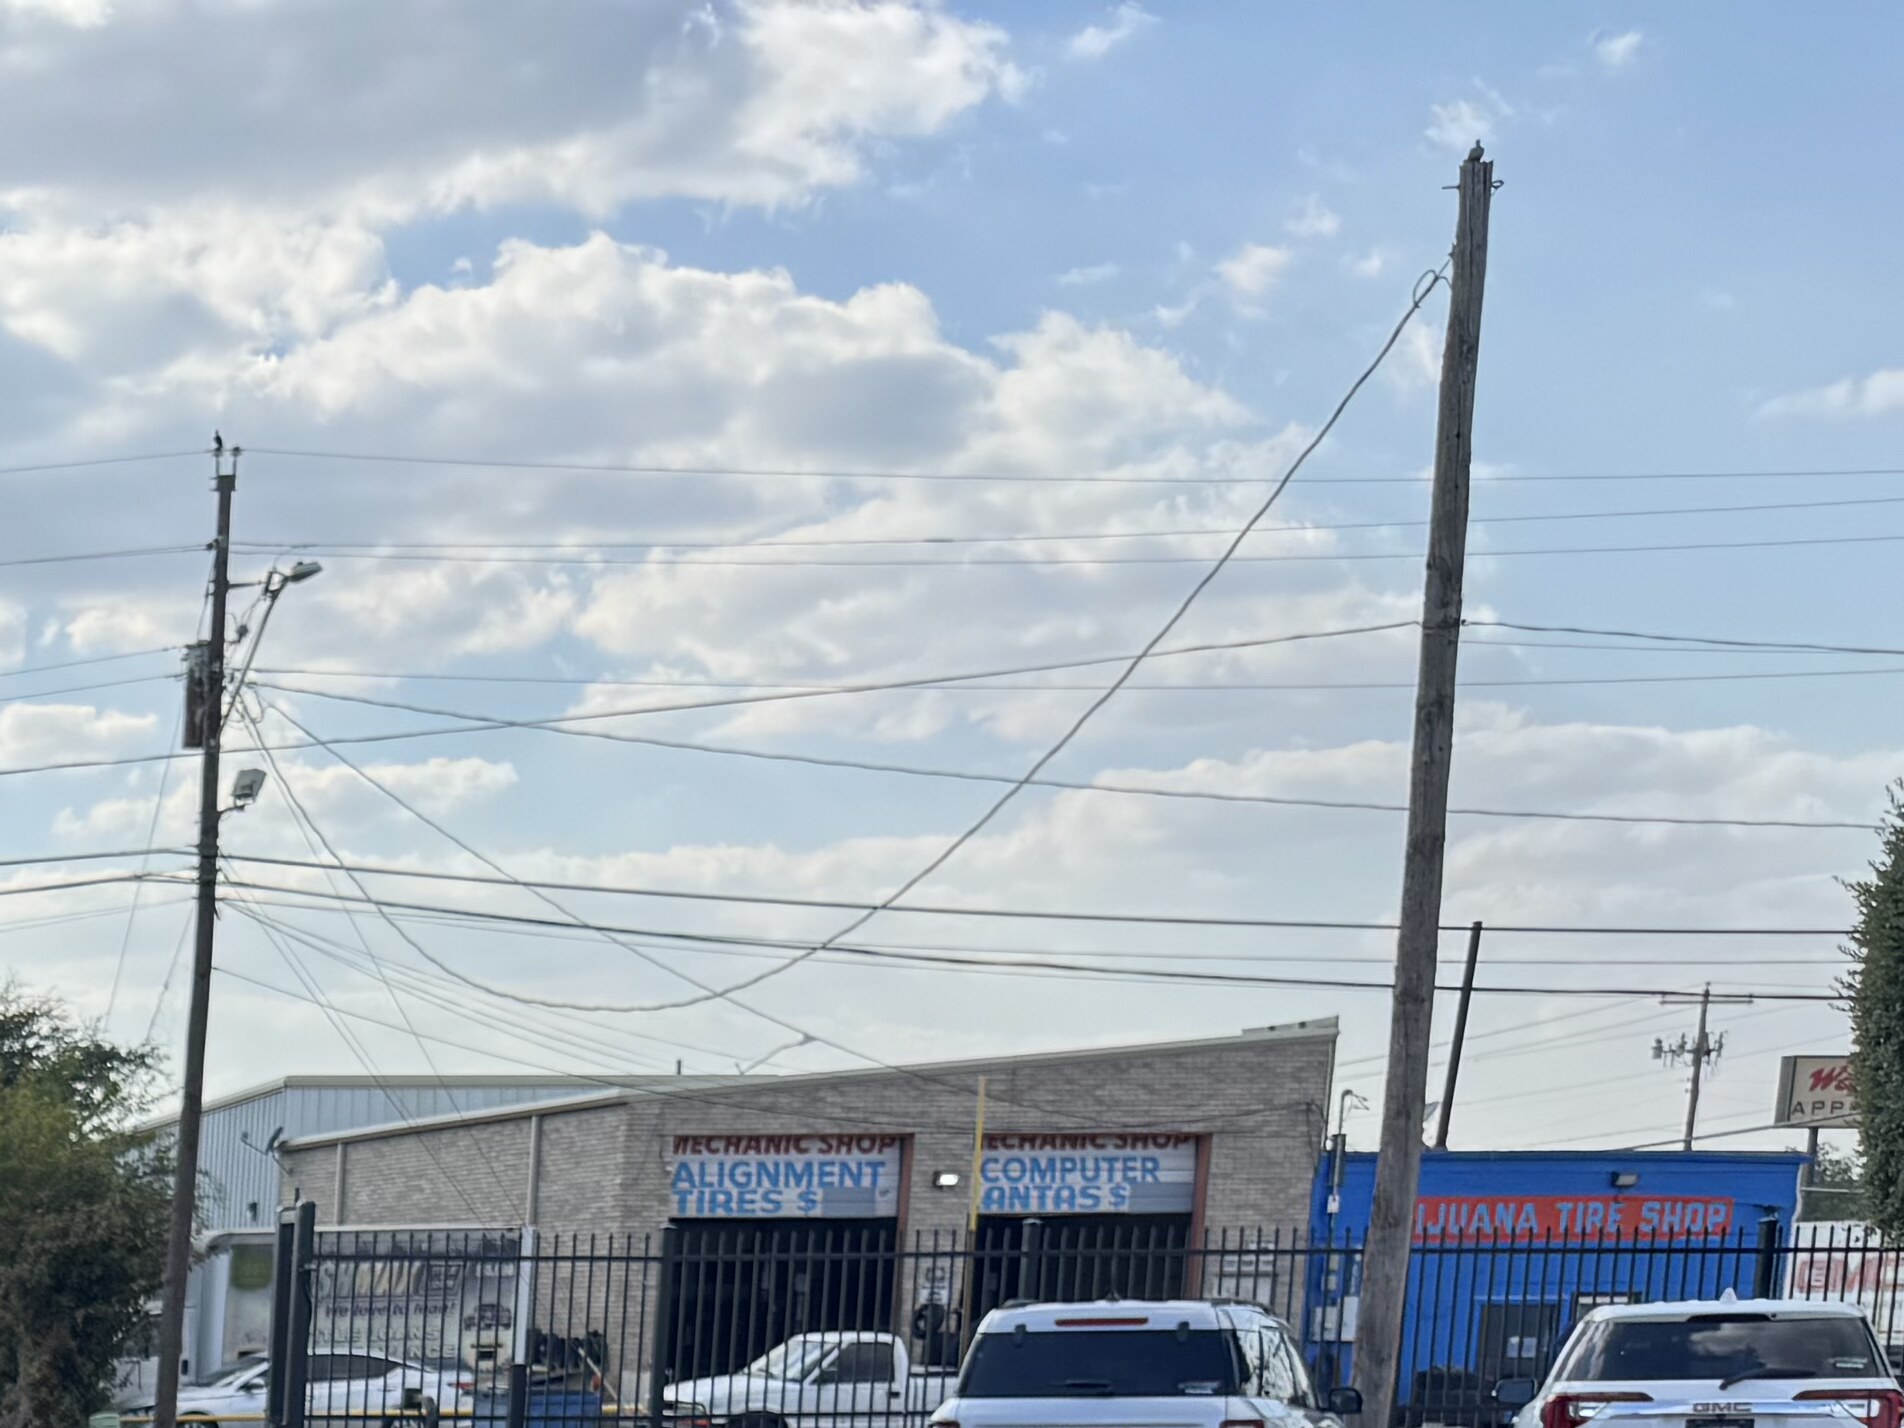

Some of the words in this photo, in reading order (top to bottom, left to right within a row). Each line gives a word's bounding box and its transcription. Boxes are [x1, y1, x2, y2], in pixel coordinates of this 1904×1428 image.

[1791, 1101, 1858, 1115] APP
[817, 1135, 896, 1154] SHOP
[983, 1135, 1107, 1150] ECHANIC
[671, 1160, 886, 1188] ALIGNMENT
[980, 1156, 1161, 1184] COMPUTER
[672, 1189, 784, 1216] TIRES
[982, 1185, 1102, 1211] ANTAS
[1416, 1202, 1539, 1234] IJUANA
[1555, 1201, 1624, 1233] TIRE
[1639, 1200, 1728, 1233] SHOP
[1693, 1402, 1753, 1413] GMC
